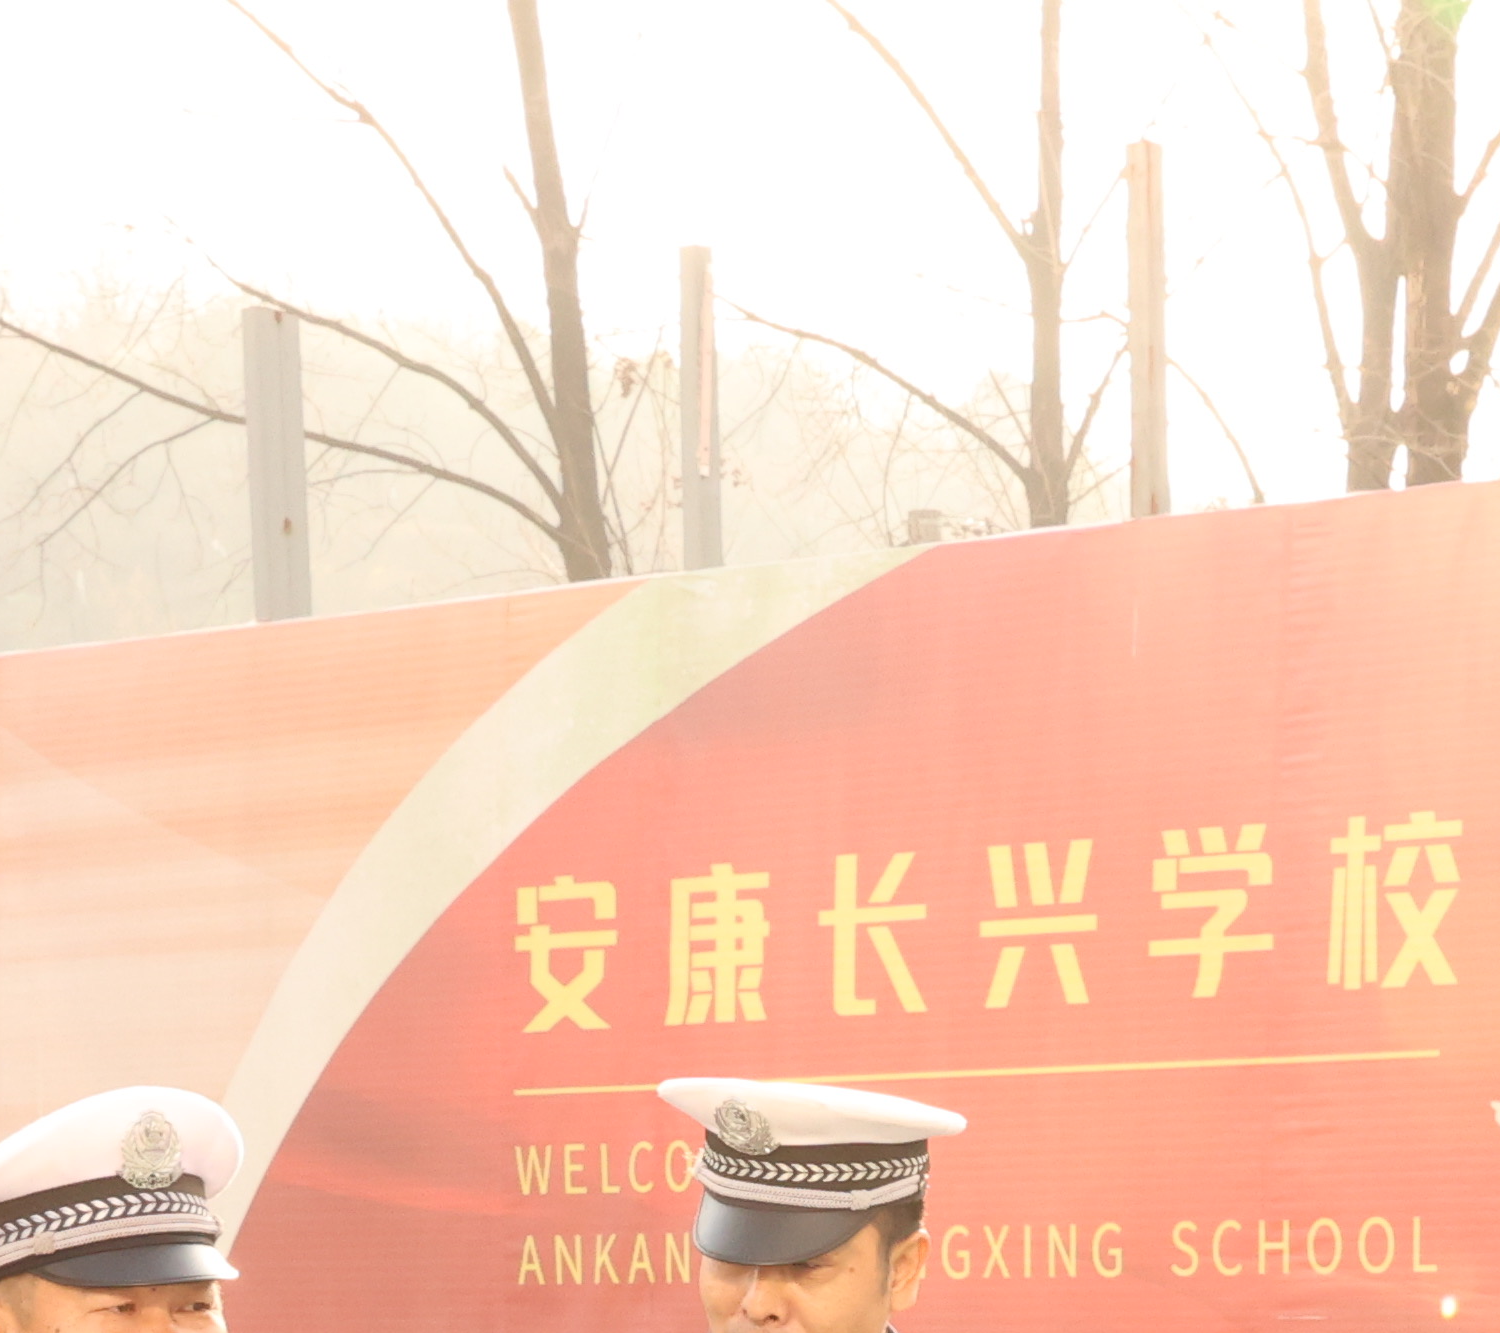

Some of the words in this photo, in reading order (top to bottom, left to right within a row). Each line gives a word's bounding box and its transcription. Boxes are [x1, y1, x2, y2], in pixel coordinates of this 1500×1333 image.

[513, 810, 1464, 1033] 安康长兴学校
[918, 1222, 1124, 1279] GXING
[1170, 1216, 1439, 1277] SCHOOL
